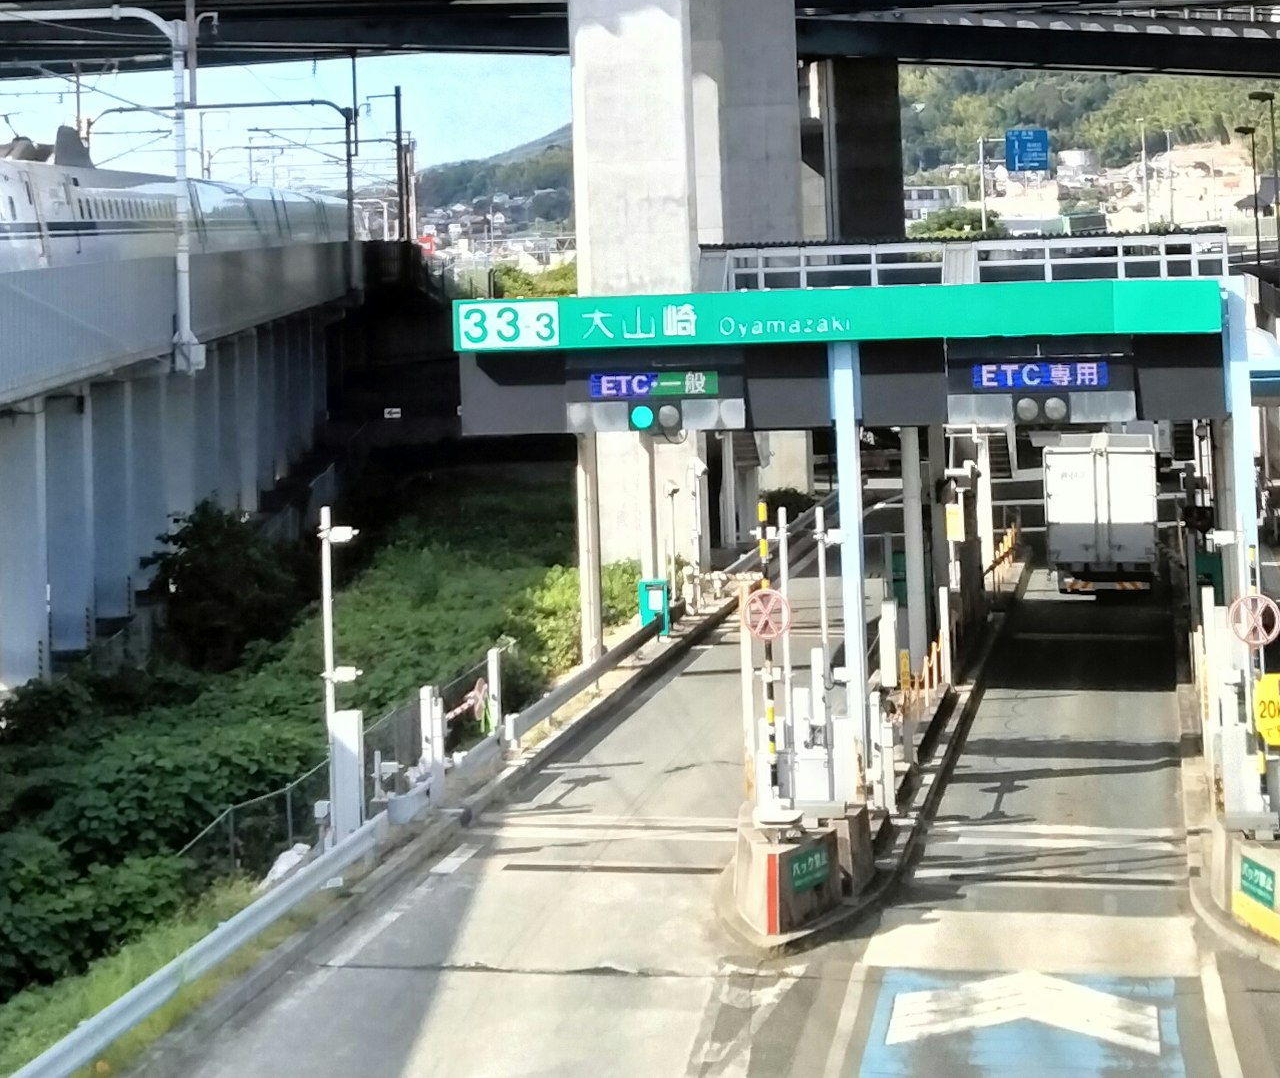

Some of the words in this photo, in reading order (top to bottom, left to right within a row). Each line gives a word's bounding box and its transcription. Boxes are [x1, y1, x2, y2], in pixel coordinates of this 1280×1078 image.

[464, 307, 555, 343] 33-3
[582, 304, 697, 338] 大山崎
[720, 316, 851, 337] Oyamazaki
